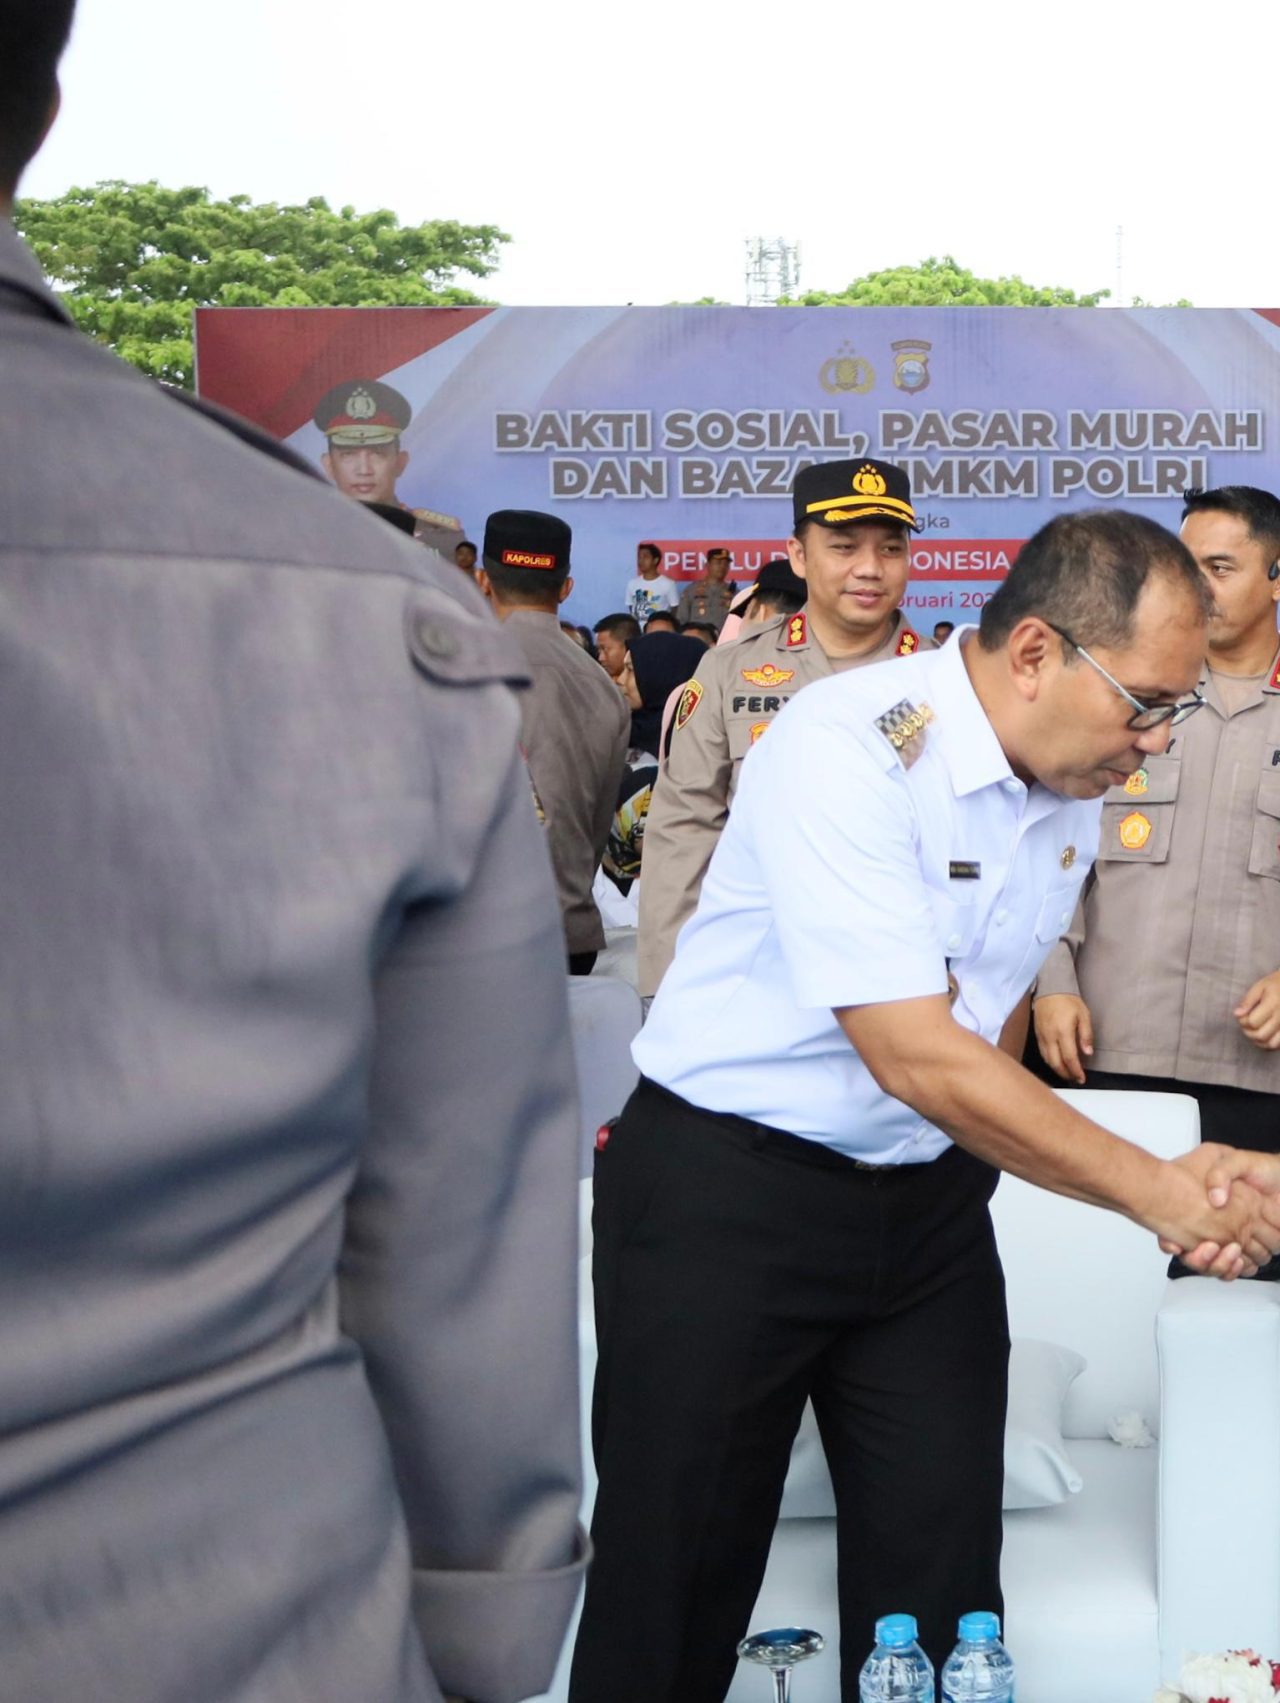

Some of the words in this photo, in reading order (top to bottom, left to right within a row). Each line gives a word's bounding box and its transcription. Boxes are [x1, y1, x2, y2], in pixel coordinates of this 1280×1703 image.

[494, 411, 651, 449] BAKTI
[664, 411, 869, 456] SOSIAL,
[880, 411, 1057, 449] PASAR
[1069, 411, 1260, 449] MURAH
[552, 458, 665, 497] DAN
[682, 458, 820, 496] BAZ
[897, 458, 1037, 496] MKM
[1050, 458, 1204, 496] POLRI
[914, 513, 950, 533] gka
[506, 553, 551, 567] KAPOLRES
[664, 552, 762, 571] PELU
[907, 550, 1011, 571] ONESIA
[732, 695, 791, 714] FER
